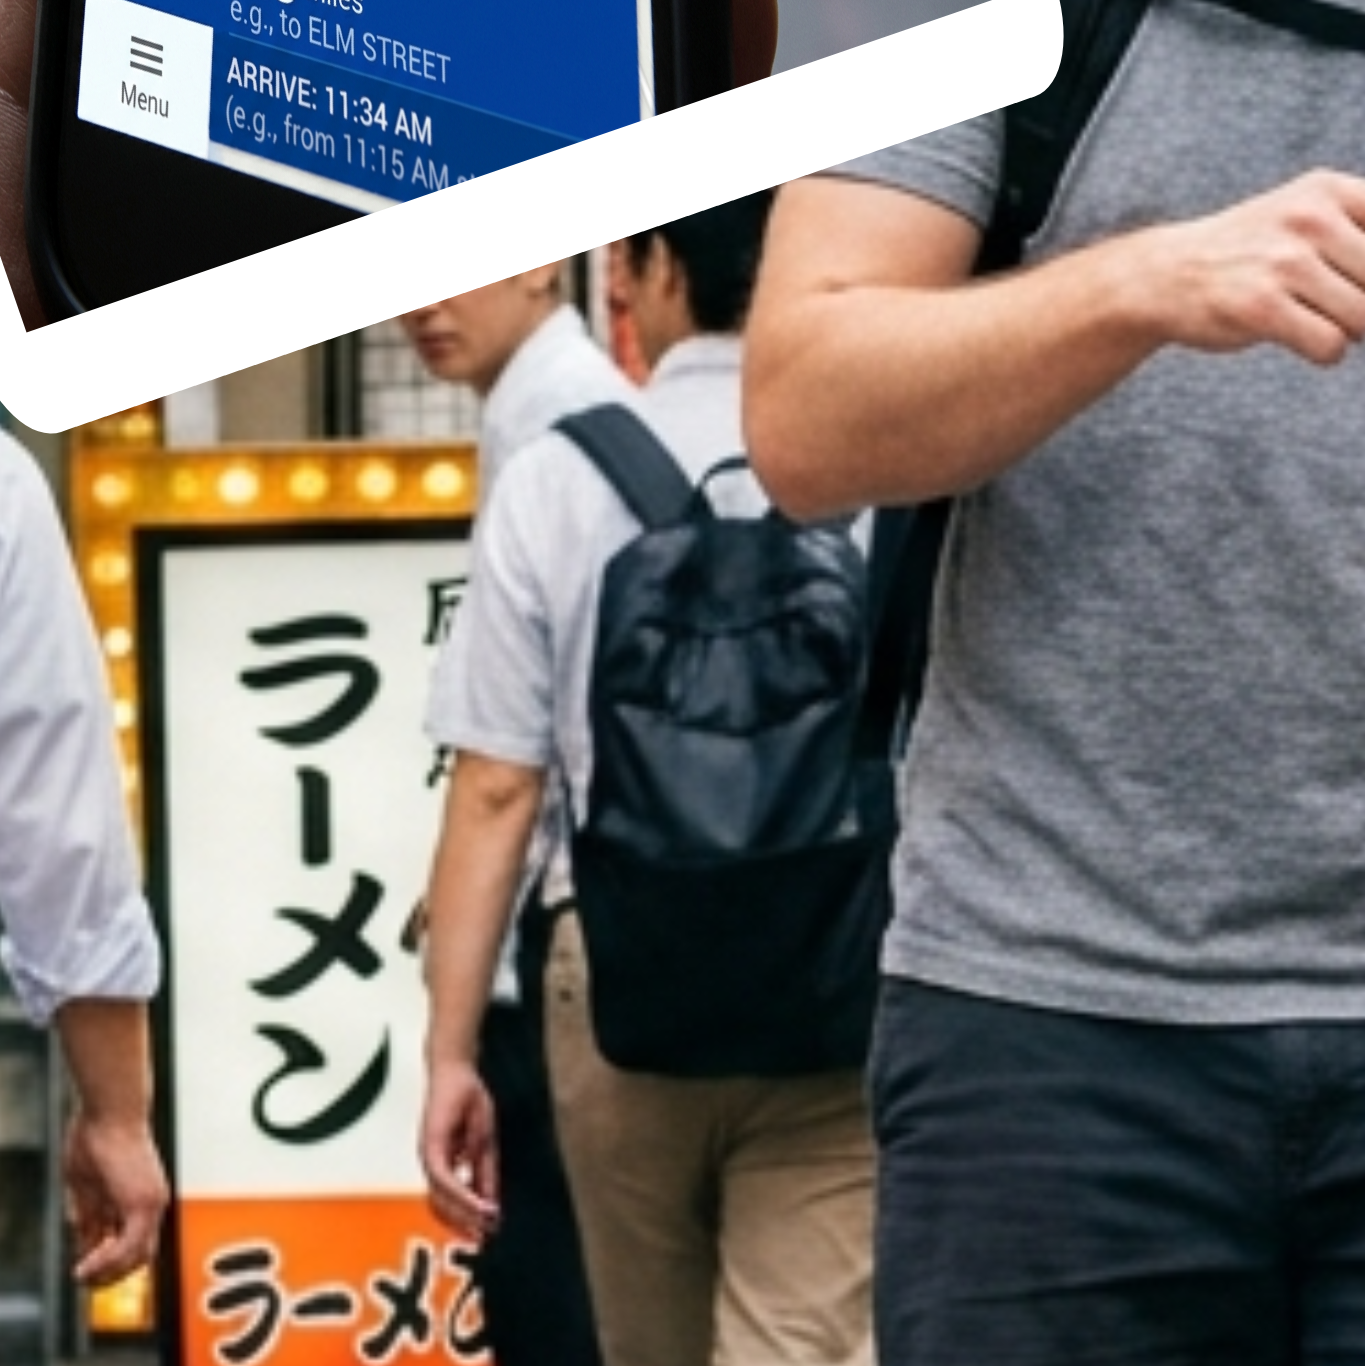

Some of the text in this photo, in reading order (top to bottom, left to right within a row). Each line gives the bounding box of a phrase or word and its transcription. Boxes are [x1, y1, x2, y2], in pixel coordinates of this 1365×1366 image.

[229, 0, 452, 84] e.g., to ELM STREET
[120, 79, 170, 119] Menu
[226, 56, 433, 148] ARRIVE: 11:34 AM
[283, 116, 336, 159] from
[342, 133, 406, 181] 11:15
[411, 155, 449, 192] AM
[238, 611, 391, 1147] ラーメン
